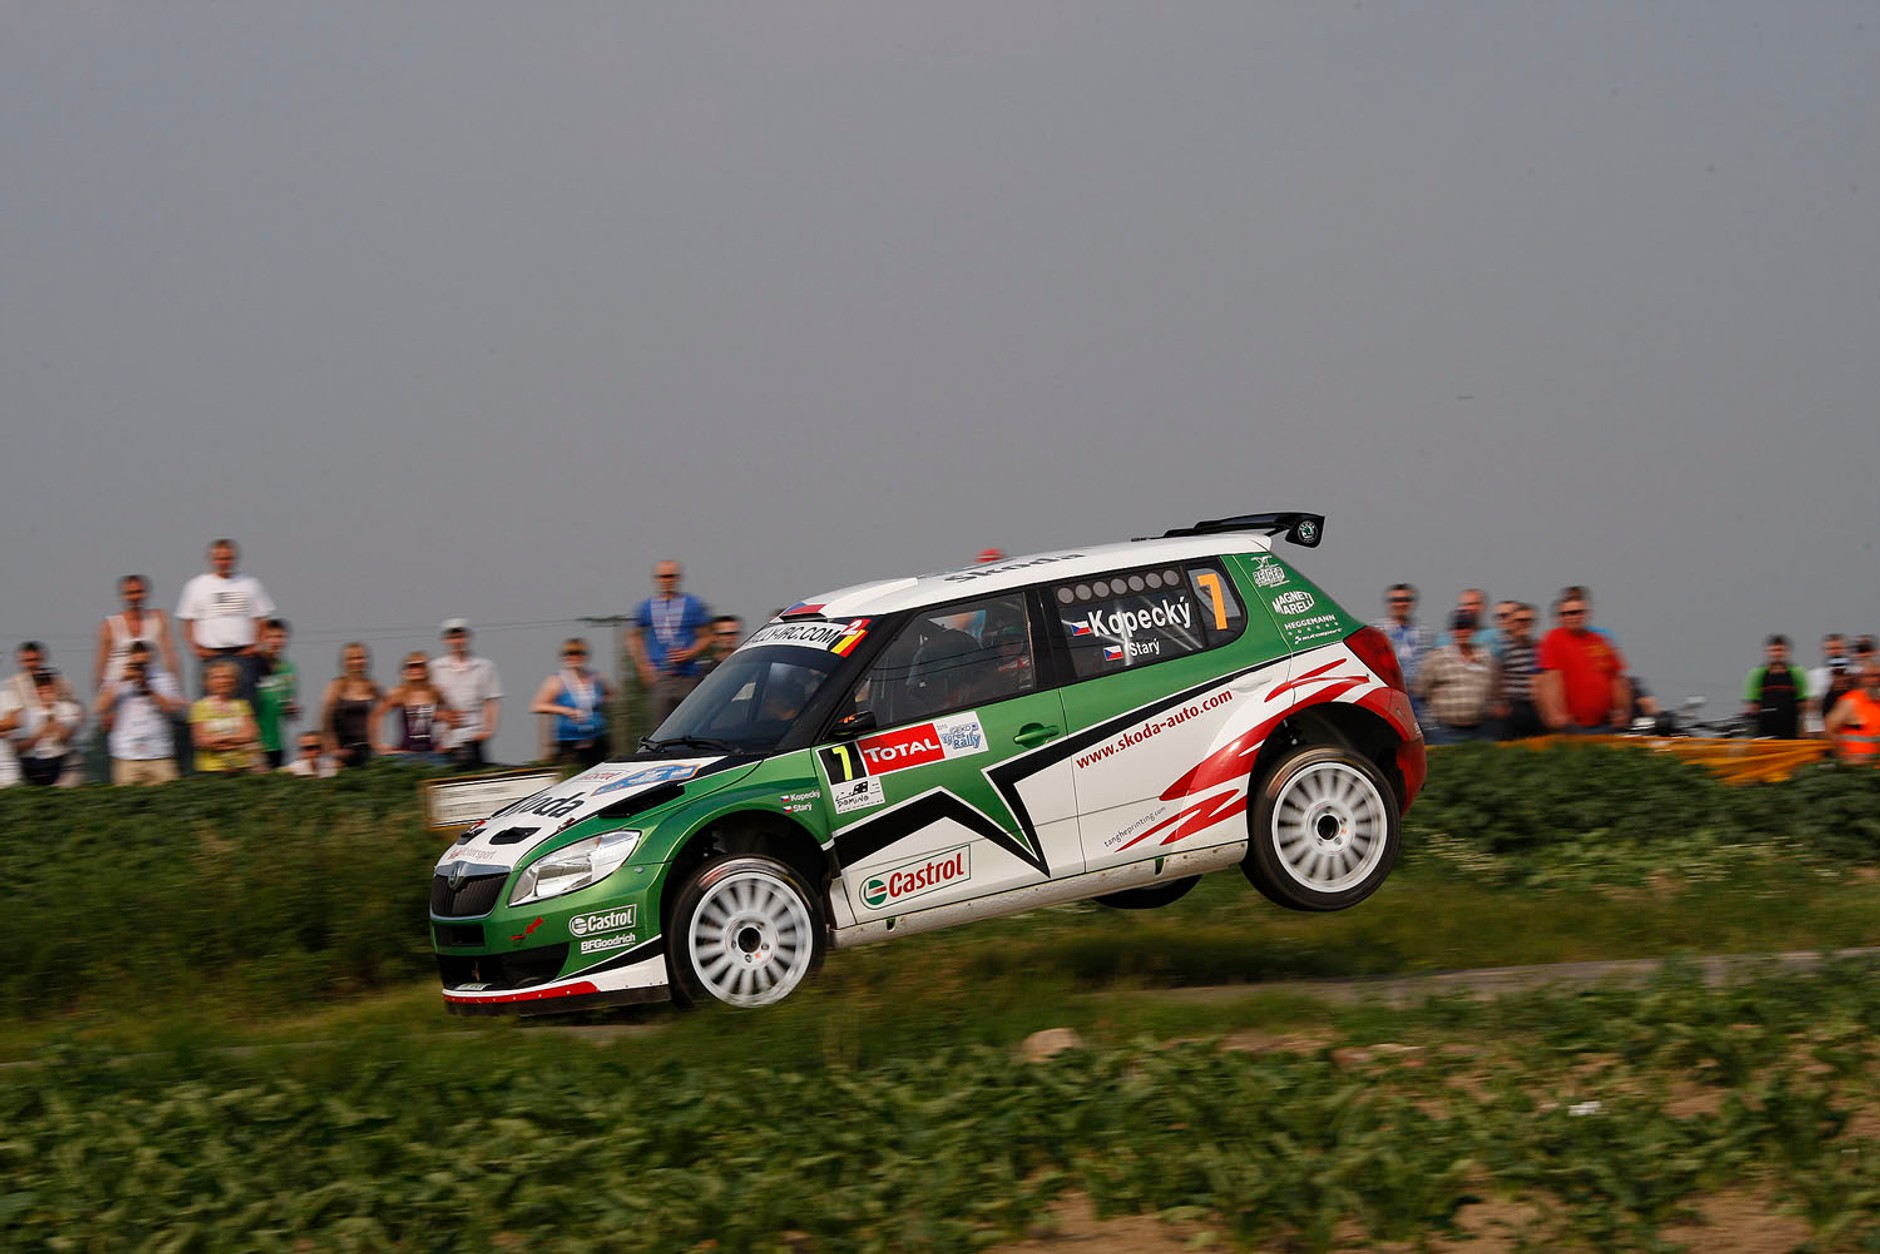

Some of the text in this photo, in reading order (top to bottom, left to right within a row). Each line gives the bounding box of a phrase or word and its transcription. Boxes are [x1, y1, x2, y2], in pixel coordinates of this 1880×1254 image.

[840, 619, 863, 635] 2
[1088, 596, 1191, 638] Kopecký
[1284, 614, 1336, 630] HEGGEMANN
[1129, 638, 1160, 657] Starý
[1076, 689, 1234, 769] www.skoda-auto.com
[863, 738, 940, 763] TOTAL
[833, 745, 853, 781] 7
[889, 852, 964, 898] Castrol
[588, 909, 632, 931] Castrol
[581, 932, 636, 951] BFGoodrich
